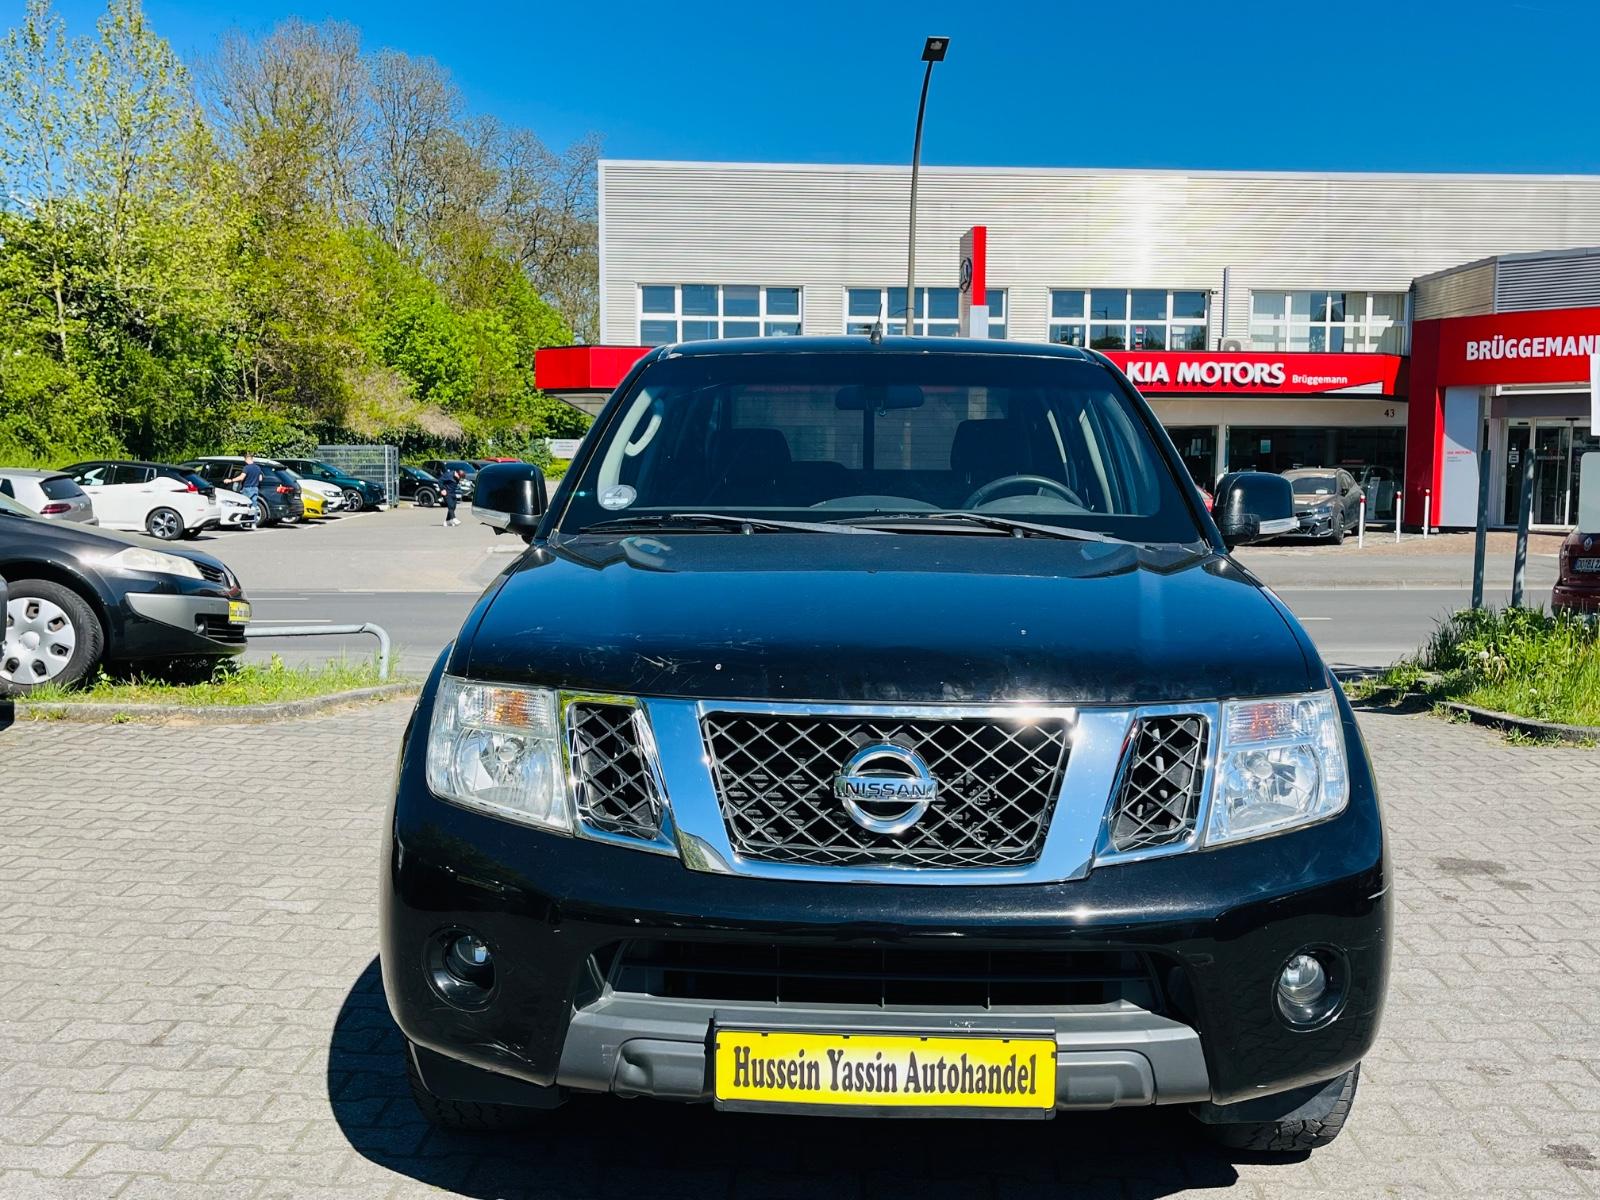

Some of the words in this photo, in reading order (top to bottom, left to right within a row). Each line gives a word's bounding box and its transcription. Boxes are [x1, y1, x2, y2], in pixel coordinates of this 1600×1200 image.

[1466, 335, 1600, 361] BRÜGGEMAN
[1127, 361, 1170, 383] KIA
[1176, 361, 1285, 385] MOTORS
[1291, 374, 1348, 385] Brüggemann
[1384, 408, 1395, 418] 43
[845, 782, 926, 796] NISSAN
[733, 1046, 820, 1089] Hussein
[827, 1049, 897, 1093] Yassin
[903, 1051, 1037, 1095] Autohandel
